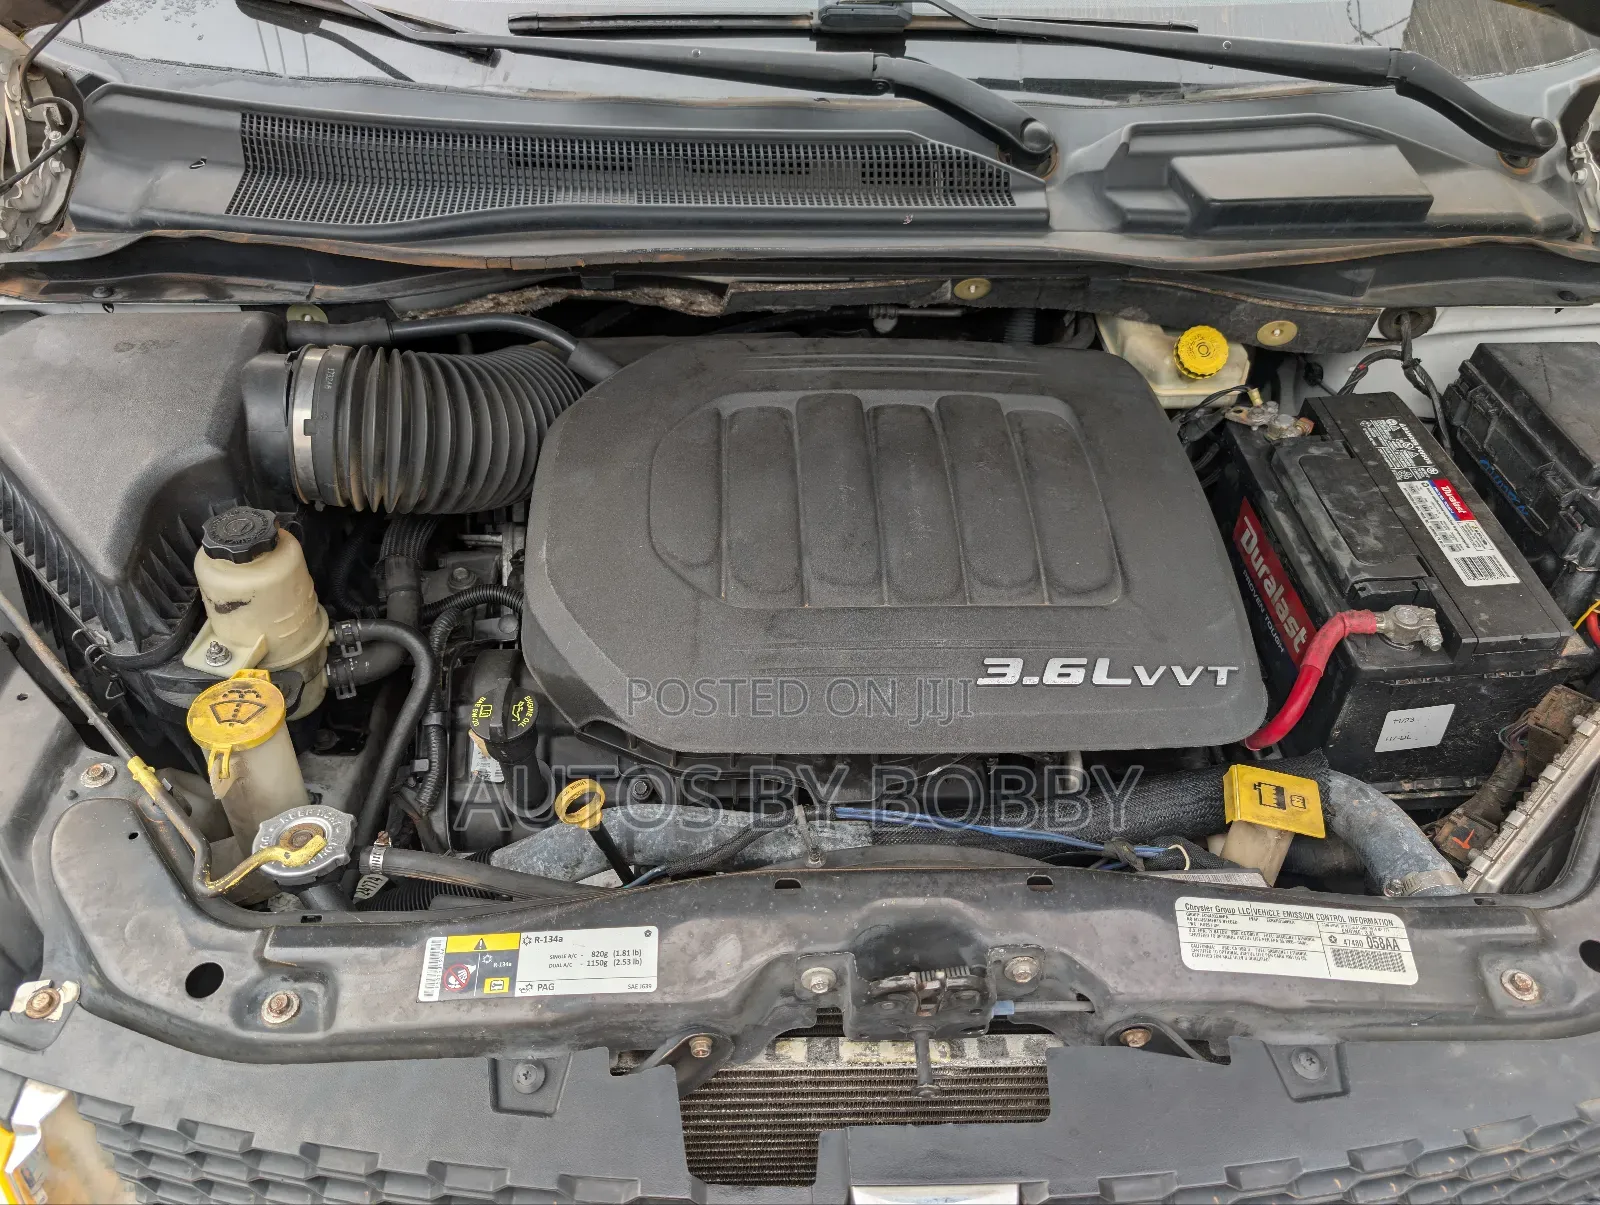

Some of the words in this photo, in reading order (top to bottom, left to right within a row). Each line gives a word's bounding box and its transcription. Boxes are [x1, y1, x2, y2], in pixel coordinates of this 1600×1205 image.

[1440, 485, 1468, 514] Duralast
[1240, 515, 1307, 654] Duralast
[1243, 569, 1265, 614] PROVEN
[1264, 613, 1285, 653] TOUGH
[976, 657, 1132, 688] 3.6L
[1133, 664, 1240, 688] VVT
[524, 695, 534, 718] ENGINE
[517, 717, 530, 728] OIL
[1184, 902, 1213, 913] Chrysler
[1215, 904, 1236, 915] Group
[1252, 907, 1281, 917] VEHICLE
[1282, 910, 1314, 920] EMISSION
[1316, 914, 1347, 923] CONTROL
[1348, 915, 1394, 926] INFORMATION
[534, 935, 564, 944] R-134a
[1366, 935, 1401, 951] 058AA
[591, 950, 608, 959] 820g
[612, 949, 631, 958] (1.81
[632, 949, 642, 957] lb)
[586, 960, 608, 968] 1150g
[613, 959, 631, 967] (2.53
[632, 958, 643, 967] lb)
[537, 983, 555, 991] PAG
